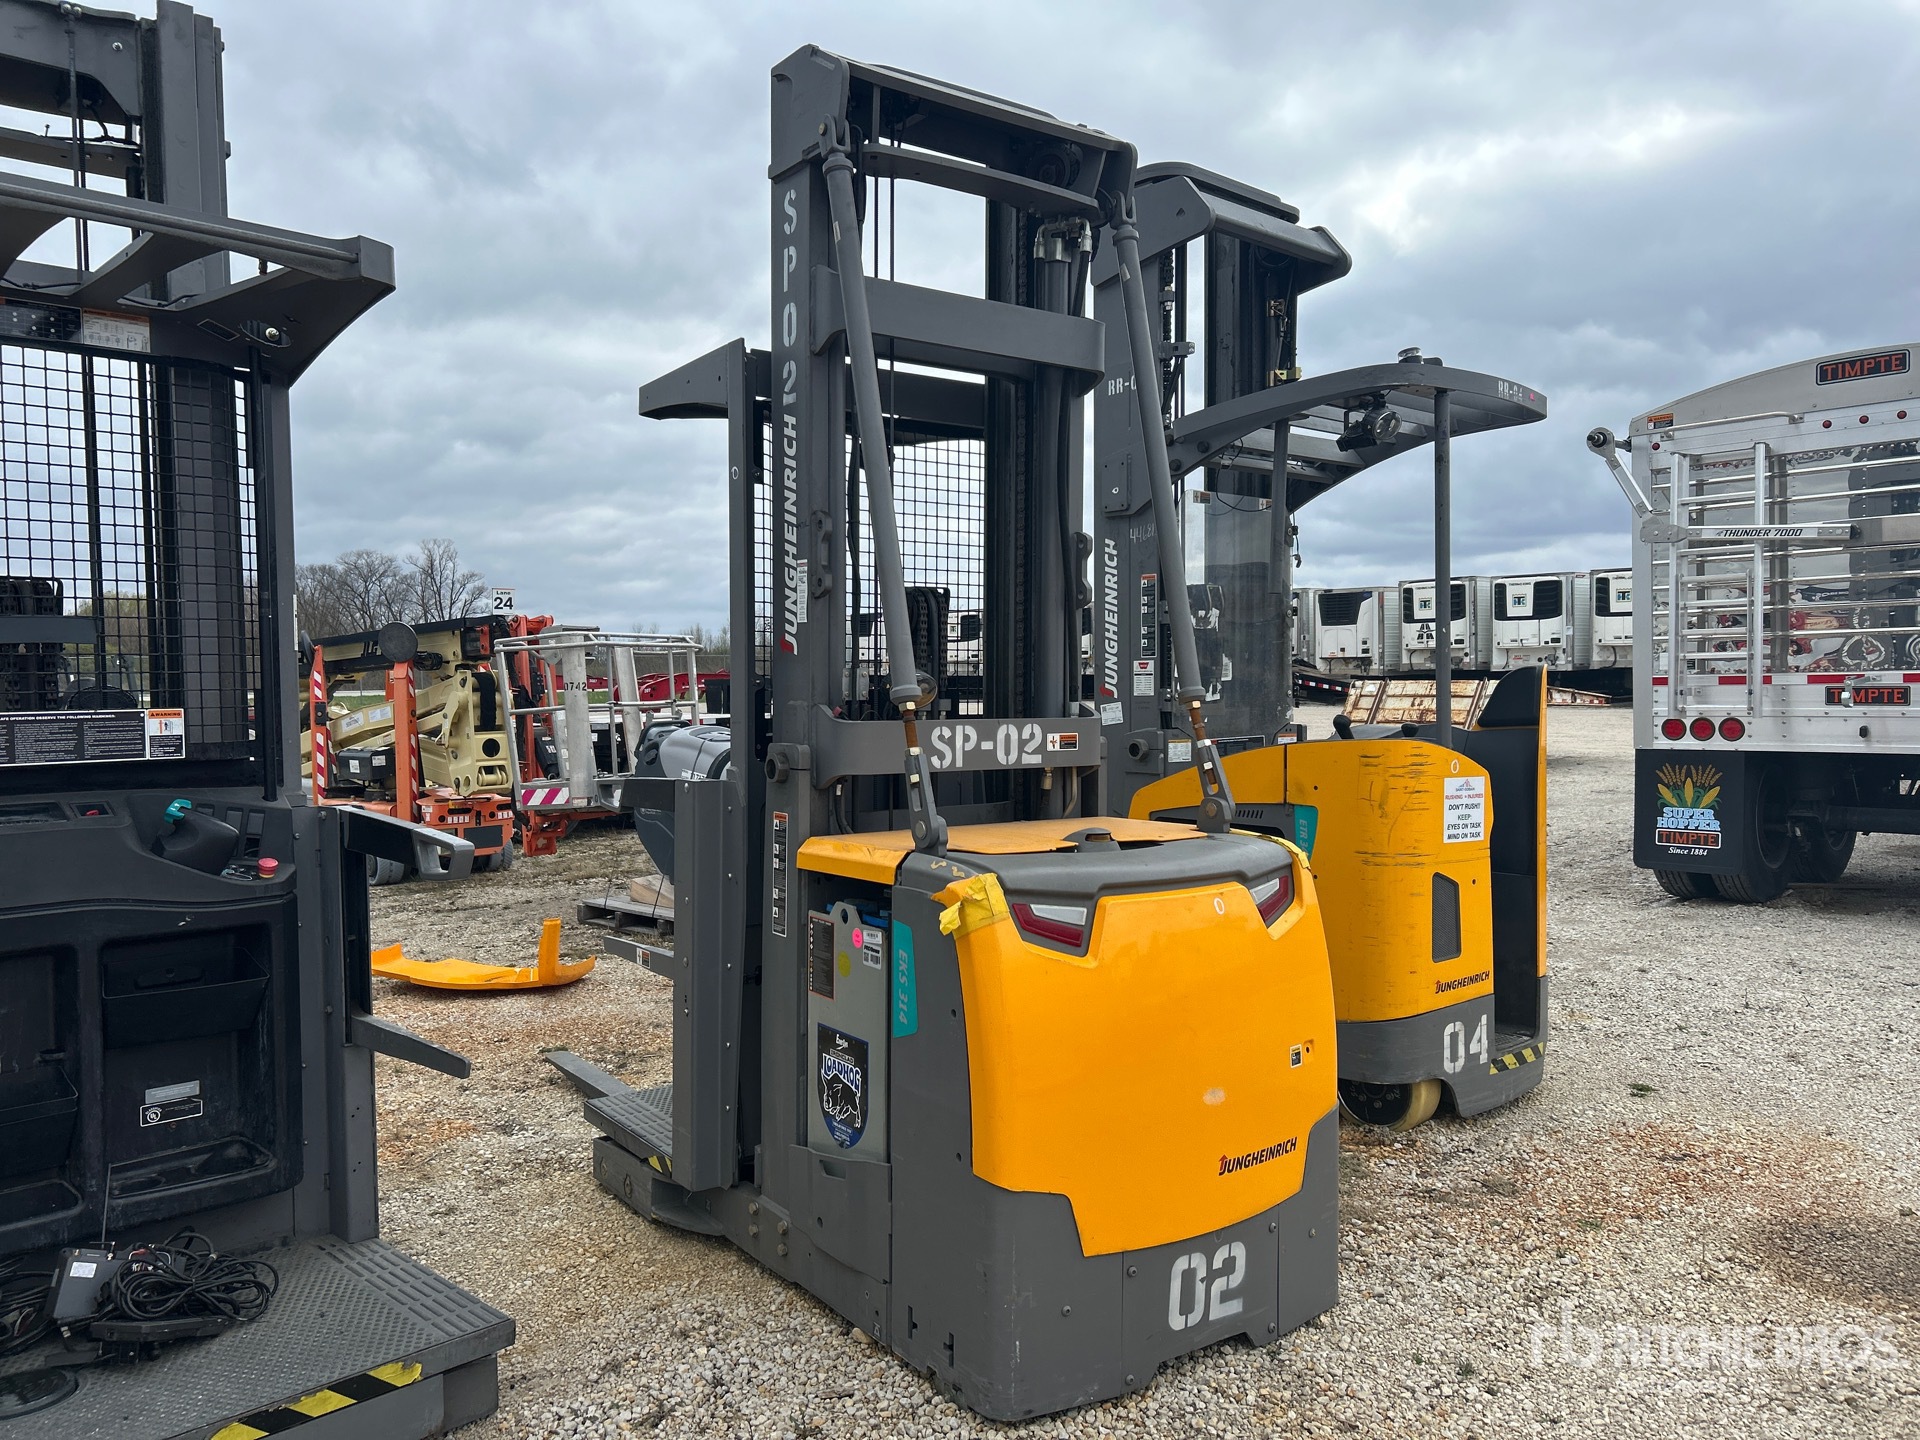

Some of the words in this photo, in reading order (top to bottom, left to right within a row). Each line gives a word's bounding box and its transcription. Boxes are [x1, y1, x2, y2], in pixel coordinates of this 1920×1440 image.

[1823, 354, 1903, 381] TIMPTE
[780, 413, 798, 656] JUNGHEINRICH
[1723, 529, 1771, 537] THUNDER
[1774, 528, 1804, 537] 7000
[493, 596, 514, 610] 24
[1100, 538, 1118, 699] JUNGHEINRICH
[1830, 688, 1905, 703] TMPTE
[930, 723, 1043, 769] SP-02
[1448, 803, 1464, 811] DON'T
[1663, 806, 1715, 820] SUPER
[1299, 819, 1308, 839] ETR
[1447, 823, 1461, 831] EYES
[1461, 822, 1469, 830] ON
[1469, 831, 1481, 839] TASK
[1656, 817, 1721, 831] HOPPER
[1660, 831, 1717, 846] TIMPTE
[1668, 847, 1689, 855] Since
[1690, 848, 1708, 856] 1884
[898, 949, 908, 987] EKS
[1435, 970, 1490, 994] JUNGHEINRICH
[898, 988, 908, 1025] 314
[1443, 1013, 1488, 1074] 04
[822, 1053, 861, 1097] LOADHOG
[1218, 1136, 1297, 1176] JUNGHEINRICH
[1168, 1241, 1246, 1331] 02
